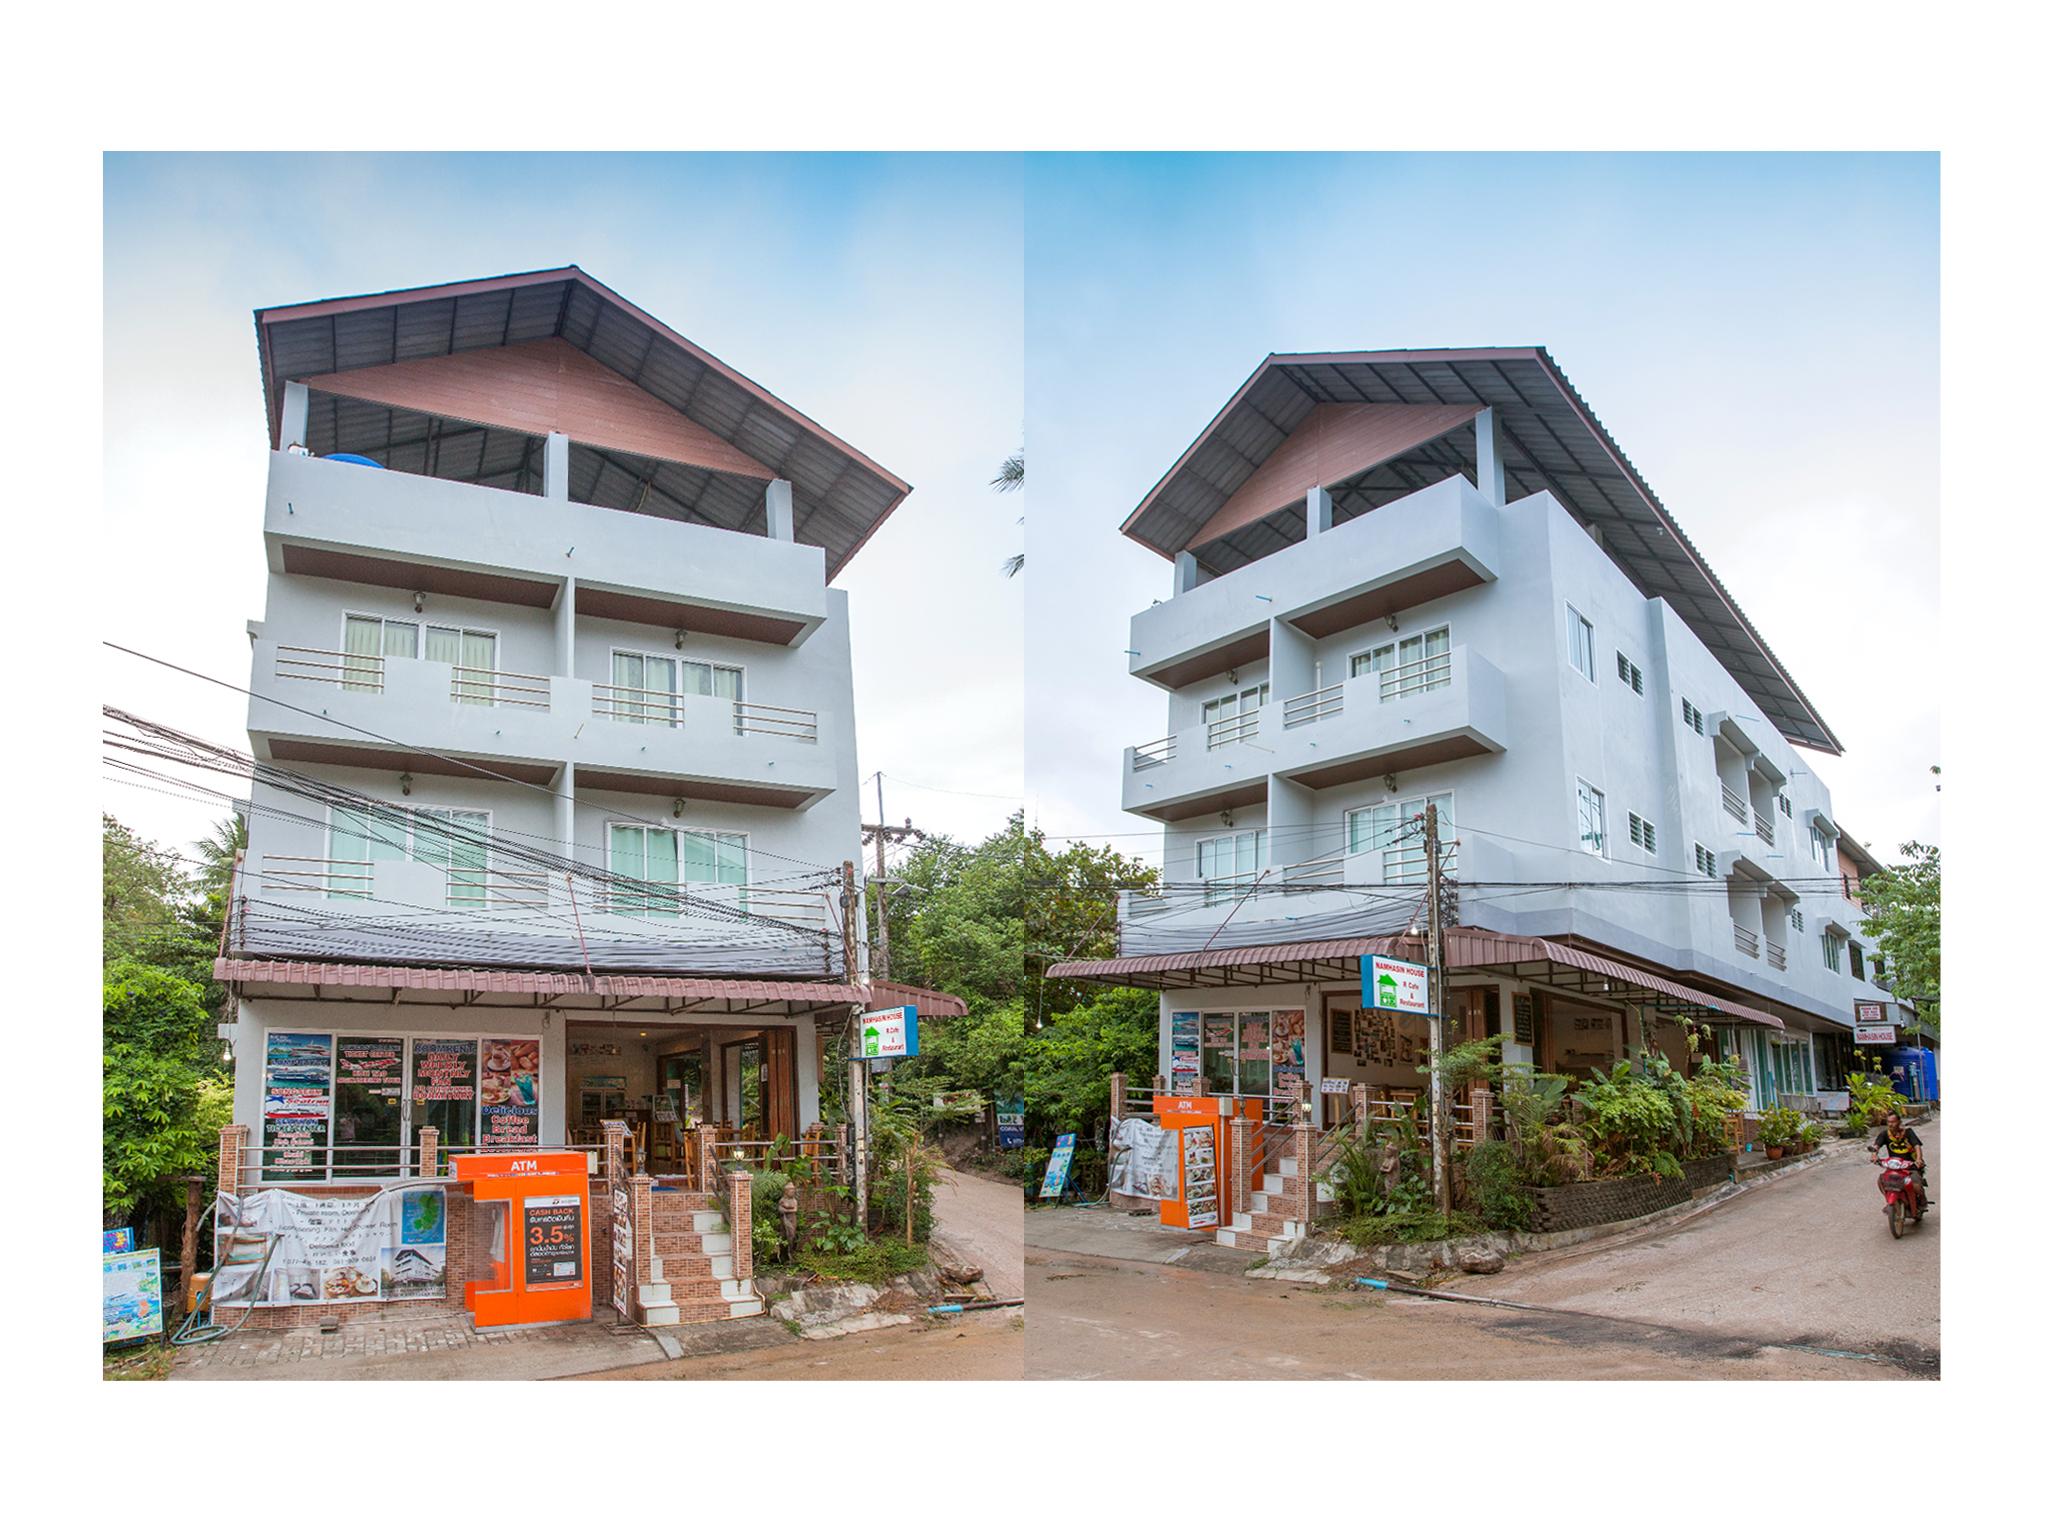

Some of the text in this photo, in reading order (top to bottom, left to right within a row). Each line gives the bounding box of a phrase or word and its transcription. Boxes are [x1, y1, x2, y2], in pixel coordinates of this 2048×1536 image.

[1376, 962, 1424, 978] NAMHASIN HOUSE
[1400, 998, 1424, 1007] Restaurant
[427, 1052, 459, 1061] DAILY
[420, 1060, 467, 1070] WEEKLY
[285, 1098, 330, 1106] Seatran
[1178, 1101, 1192, 1109] ATM
[482, 1105, 537, 1116] Delicious
[491, 1115, 530, 1125] Coffee
[492, 1125, 528, 1134] Bread
[482, 1134, 538, 1144] Breakfast
[511, 1160, 538, 1171] ATM
